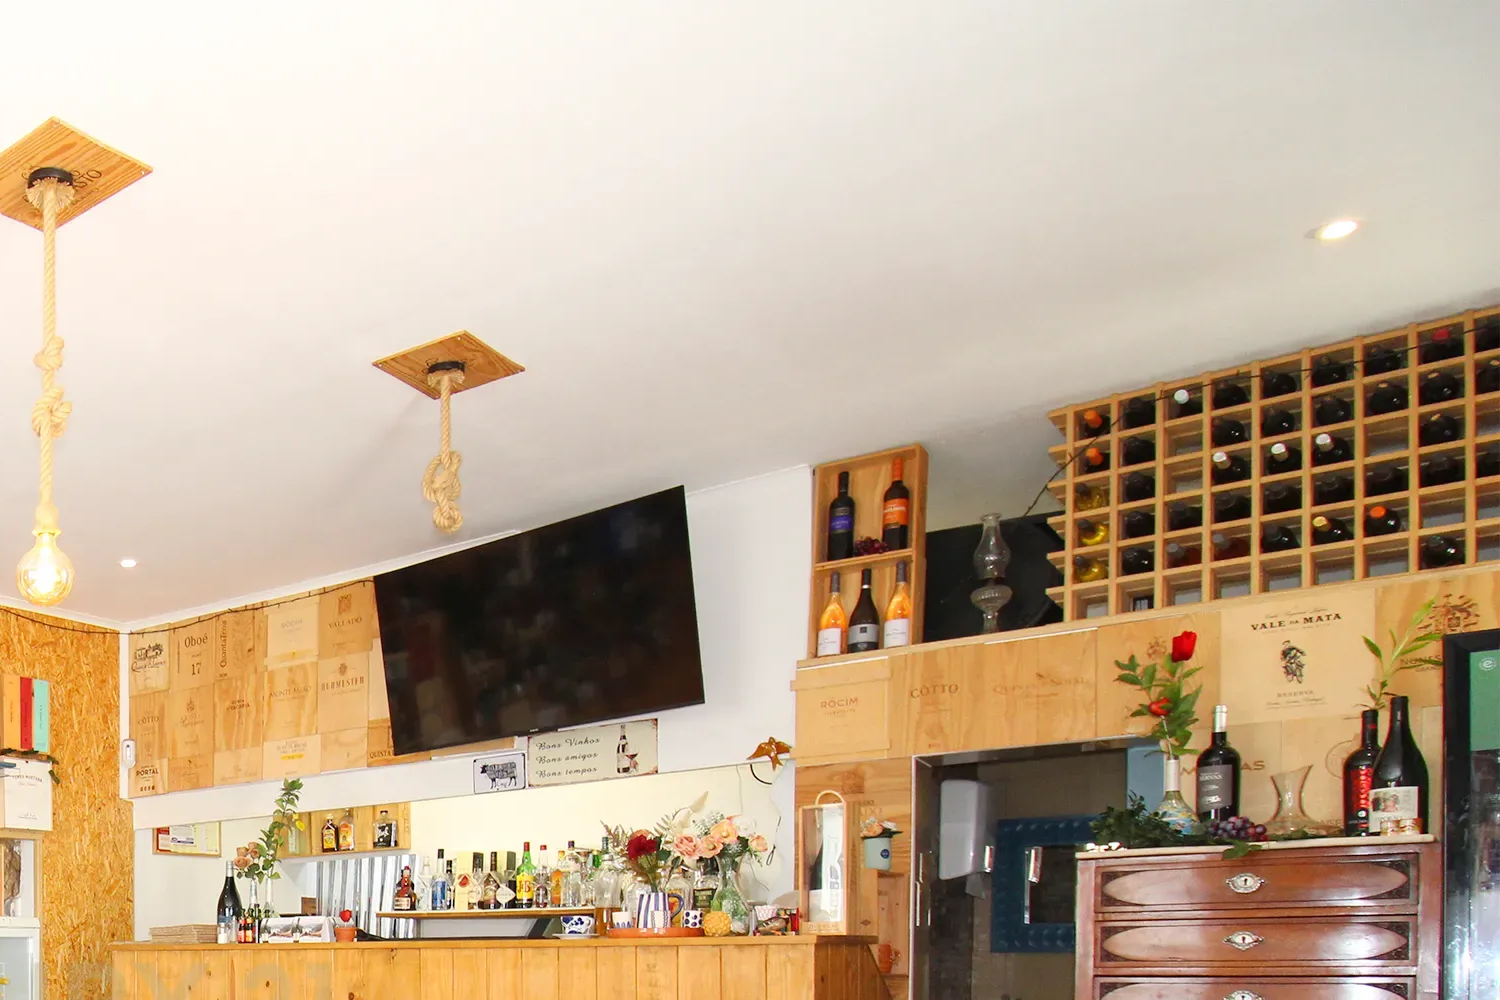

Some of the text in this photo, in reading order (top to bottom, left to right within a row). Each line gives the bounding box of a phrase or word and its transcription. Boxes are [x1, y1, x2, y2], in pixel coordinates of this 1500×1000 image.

[328, 617, 363, 629] VALLADO
[1250, 620, 1286, 631] VALE
[1302, 613, 1342, 625] MATA
[184, 633, 208, 648] Oboé
[191, 662, 202, 676] 17
[320, 676, 365, 691] BURMESTER
[536, 737, 600, 750] Bons Vinhos
[370, 750, 393, 759] QUINTA
[536, 752, 598, 764] Bons amigos
[135, 768, 159, 777] PORTAL
[536, 766, 598, 778] Bons tempos
